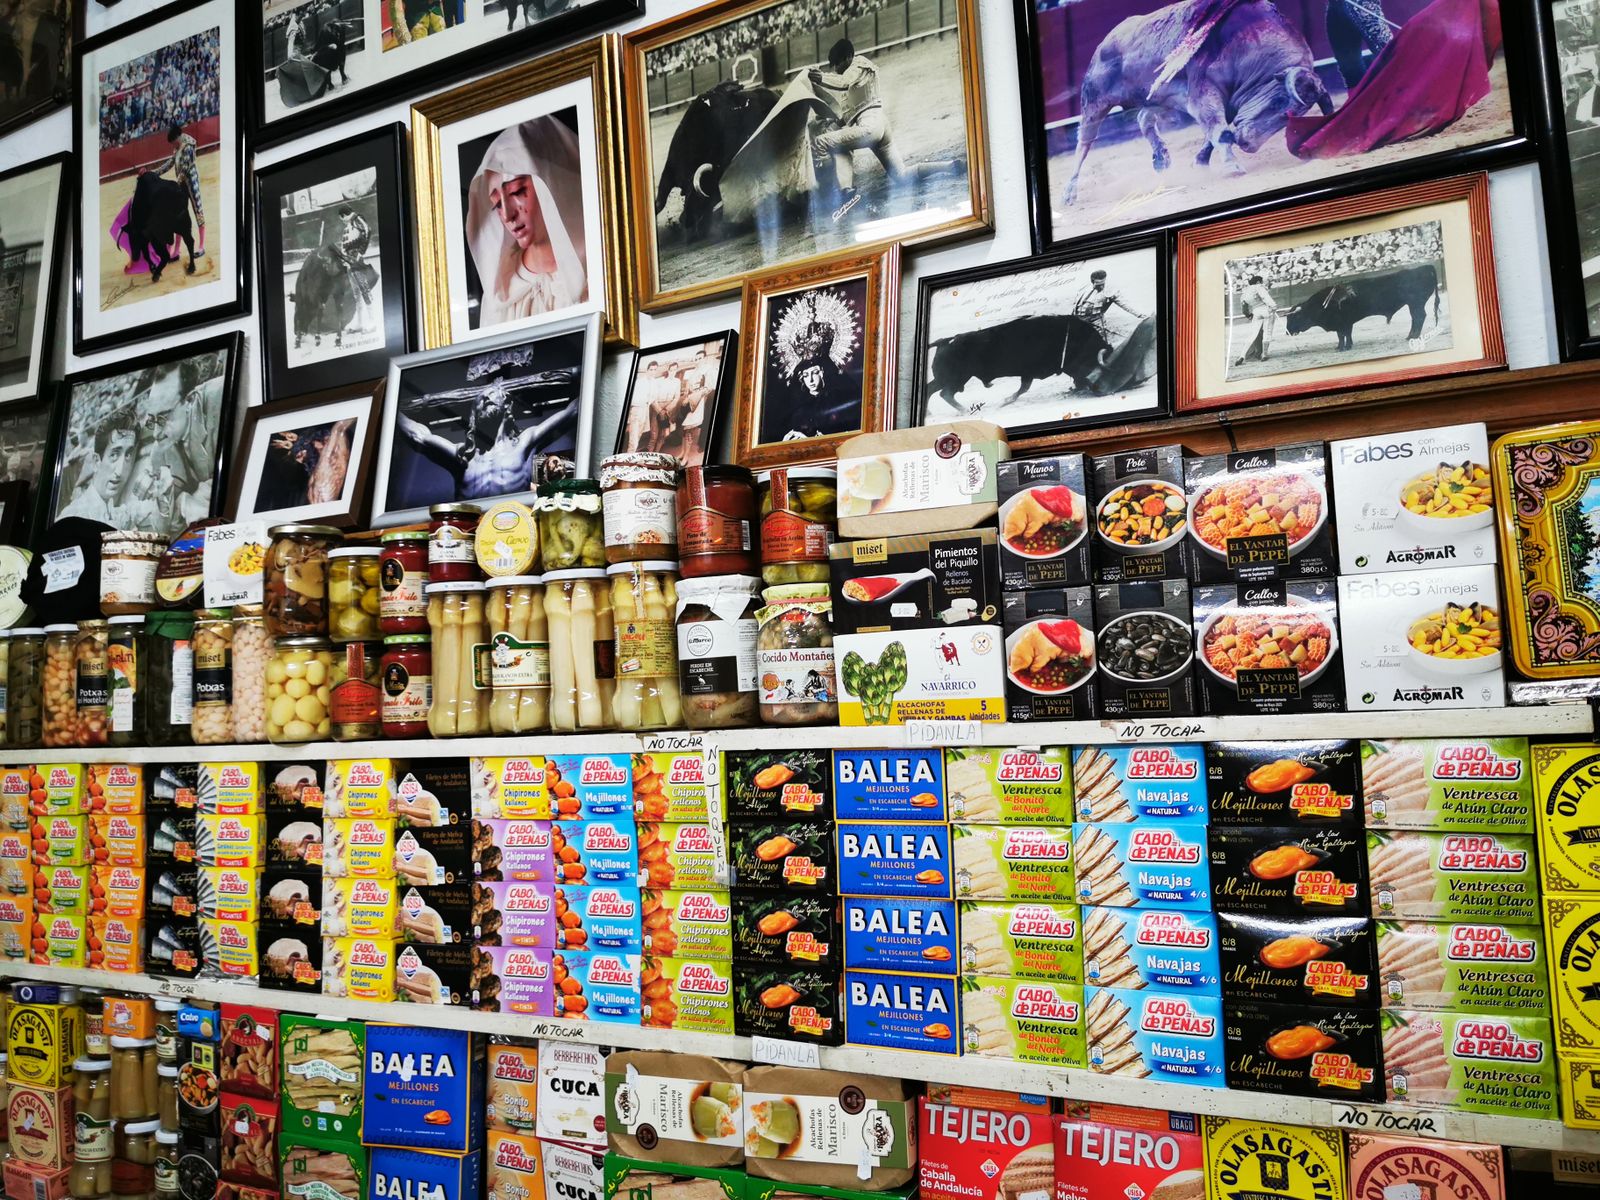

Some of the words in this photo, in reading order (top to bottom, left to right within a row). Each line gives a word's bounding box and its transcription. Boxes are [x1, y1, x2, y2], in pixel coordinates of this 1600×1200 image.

[1418, 437, 1435, 445] con
[1340, 442, 1413, 464] Fabes
[1419, 441, 1471, 457] Almejas
[1023, 463, 1055, 475] Manos
[1234, 456, 1268, 471] Callos
[919, 455, 930, 504] Marisco
[207, 528, 236, 542] Fabes
[856, 543, 884, 556] miset
[1230, 543, 1242, 551] EL
[1243, 539, 1285, 550] YANTAR
[934, 547, 978, 558] Pimientos
[1231, 555, 1245, 564] DE
[1248, 549, 1286, 562] PEPE
[1386, 545, 1457, 565] AGROMAR
[935, 560, 947, 569] del
[950, 557, 978, 569] Piquillo
[1037, 562, 1064, 571] YANTAR
[1135, 556, 1162, 566] YANTAR
[1040, 569, 1065, 579] PEPE
[1126, 568, 1138, 576] DE
[1139, 564, 1163, 574] PEPE
[1300, 566, 1320, 574] 380g
[951, 577, 973, 586] Bacalao
[1346, 577, 1421, 600] Fabes
[1427, 582, 1479, 595] Almejas
[1244, 589, 1279, 601] Callos
[197, 652, 222, 664] miset
[762, 653, 788, 663] Cocido
[82, 660, 104, 671] miset
[196, 682, 225, 693] Potxas
[921, 680, 977, 691] NAVARRICO
[79, 688, 107, 698] Potxas
[1138, 691, 1168, 699] YANTAR
[1393, 685, 1464, 704] AGROMAR
[897, 701, 946, 709] ALCACHOFAS
[980, 700, 987, 711] 5
[1044, 698, 1071, 706] YANTAR
[1142, 699, 1169, 709] PEPE
[1047, 705, 1072, 715] PEPE
[969, 712, 1001, 721] Unidades
[1120, 725, 1145, 737] NO
[1150, 723, 1206, 737] TOCAR
[648, 739, 665, 750] NO
[666, 737, 703, 749] TOCAR
[707, 744, 719, 776] NO
[1002, 753, 1037, 766] CABO
[1131, 749, 1169, 763] CABO
[1439, 746, 1489, 762] CABO
[352, 765, 372, 775] CABO
[507, 762, 528, 771] CABO
[584, 761, 609, 771] CABO
[839, 759, 935, 783] BALEA
[1000, 767, 1014, 779] de
[1015, 765, 1060, 779] PEÑAS
[1129, 763, 1144, 776] de
[1145, 762, 1194, 777] PEÑAS
[1208, 767, 1223, 775] 6/8
[1436, 761, 1455, 777] de
[1457, 760, 1518, 778] PEÑAS
[515, 770, 543, 782] PEÑAS
[594, 771, 626, 782] PEÑAS
[348, 790, 378, 801] Chipirones
[504, 788, 541, 799] Chipirones
[784, 785, 808, 795] CABO
[1002, 784, 1062, 795] Ventresca
[1293, 784, 1330, 797] CABO
[1442, 787, 1520, 801] Ventresca
[585, 792, 627, 803] Mejillones
[791, 794, 823, 805] PEÑAS
[1013, 795, 1044, 805] Bonito
[1137, 788, 1189, 805] Navajas
[1291, 797, 1306, 809] de
[1307, 795, 1352, 809] PEÑAS
[1012, 805, 1023, 813] del
[1023, 804, 1050, 815] Norte
[1152, 807, 1182, 816] NATURAL
[1187, 804, 1205, 814] 4/6
[1212, 792, 1284, 816] Mejillones
[1442, 801, 1453, 810] de
[1454, 802, 1488, 815] Atún
[1491, 802, 1528, 815] Claro
[1014, 815, 1034, 823] aceite
[1036, 815, 1045, 823] de
[1046, 815, 1065, 823] Oliva
[1223, 816, 1263, 824] ESCABECHE
[1457, 815, 1485, 825] aceite
[1488, 816, 1499, 825] de
[1501, 816, 1528, 826] Oliva
[706, 783, 726, 874] TOQUEN
[843, 834, 941, 860] BALEA
[870, 860, 916, 870] MEJILLONES
[1008, 862, 1070, 874] Ventresca
[882, 873, 913, 882] ESCABECHE
[1138, 871, 1192, 889] Navajas
[683, 895, 710, 908] CABO
[692, 908, 727, 920] PEÑAS
[849, 908, 949, 936] BALEA
[680, 925, 730, 937] Chipirones
[680, 935, 712, 945] rellenos
[592, 992, 636, 1005] Mejillones
[851, 982, 949, 1014] BALEA
[12, 1013, 50, 1047] OLASAGASTI
[532, 1023, 549, 1036] NO
[550, 1024, 585, 1039] TOCAR
[1016, 1021, 1079, 1036] Ventresca
[554, 1050, 598, 1065] BERBERECHOS
[1151, 1042, 1206, 1062] Navajas
[370, 1051, 455, 1077] BALEA
[498, 1053, 521, 1067] CABO
[505, 1066, 535, 1080] PEÑAS
[1230, 1054, 1303, 1080] Mejillones
[1463, 1066, 1542, 1084] Ventresca
[388, 1081, 440, 1092] MEJILLONES
[550, 1077, 600, 1097] CUCA
[391, 1097, 400, 1105] EN
[401, 1098, 436, 1107] ESCABECHE
[504, 1096, 529, 1107] Bonito
[659, 1083, 668, 1133] Marisco
[924, 1103, 1031, 1147] TEJERO
[1170, 1118, 1194, 1132] UBAGO
[1338, 1110, 1369, 1127] NO
[1371, 1109, 1437, 1133] TOCAR
[816, 1116, 824, 1151] Rellenas
[827, 1103, 838, 1157] Marisco
[1060, 1122, 1181, 1171] TEJERO
[920, 1159, 940, 1170] Filetes
[940, 1162, 949, 1170] de
[920, 1168, 956, 1182] Caballa
[920, 1180, 932, 1189] de
[933, 1181, 984, 1198] Andalucía
[1057, 1182, 1079, 1191] Filetes
[1079, 1186, 1088, 1194] de
